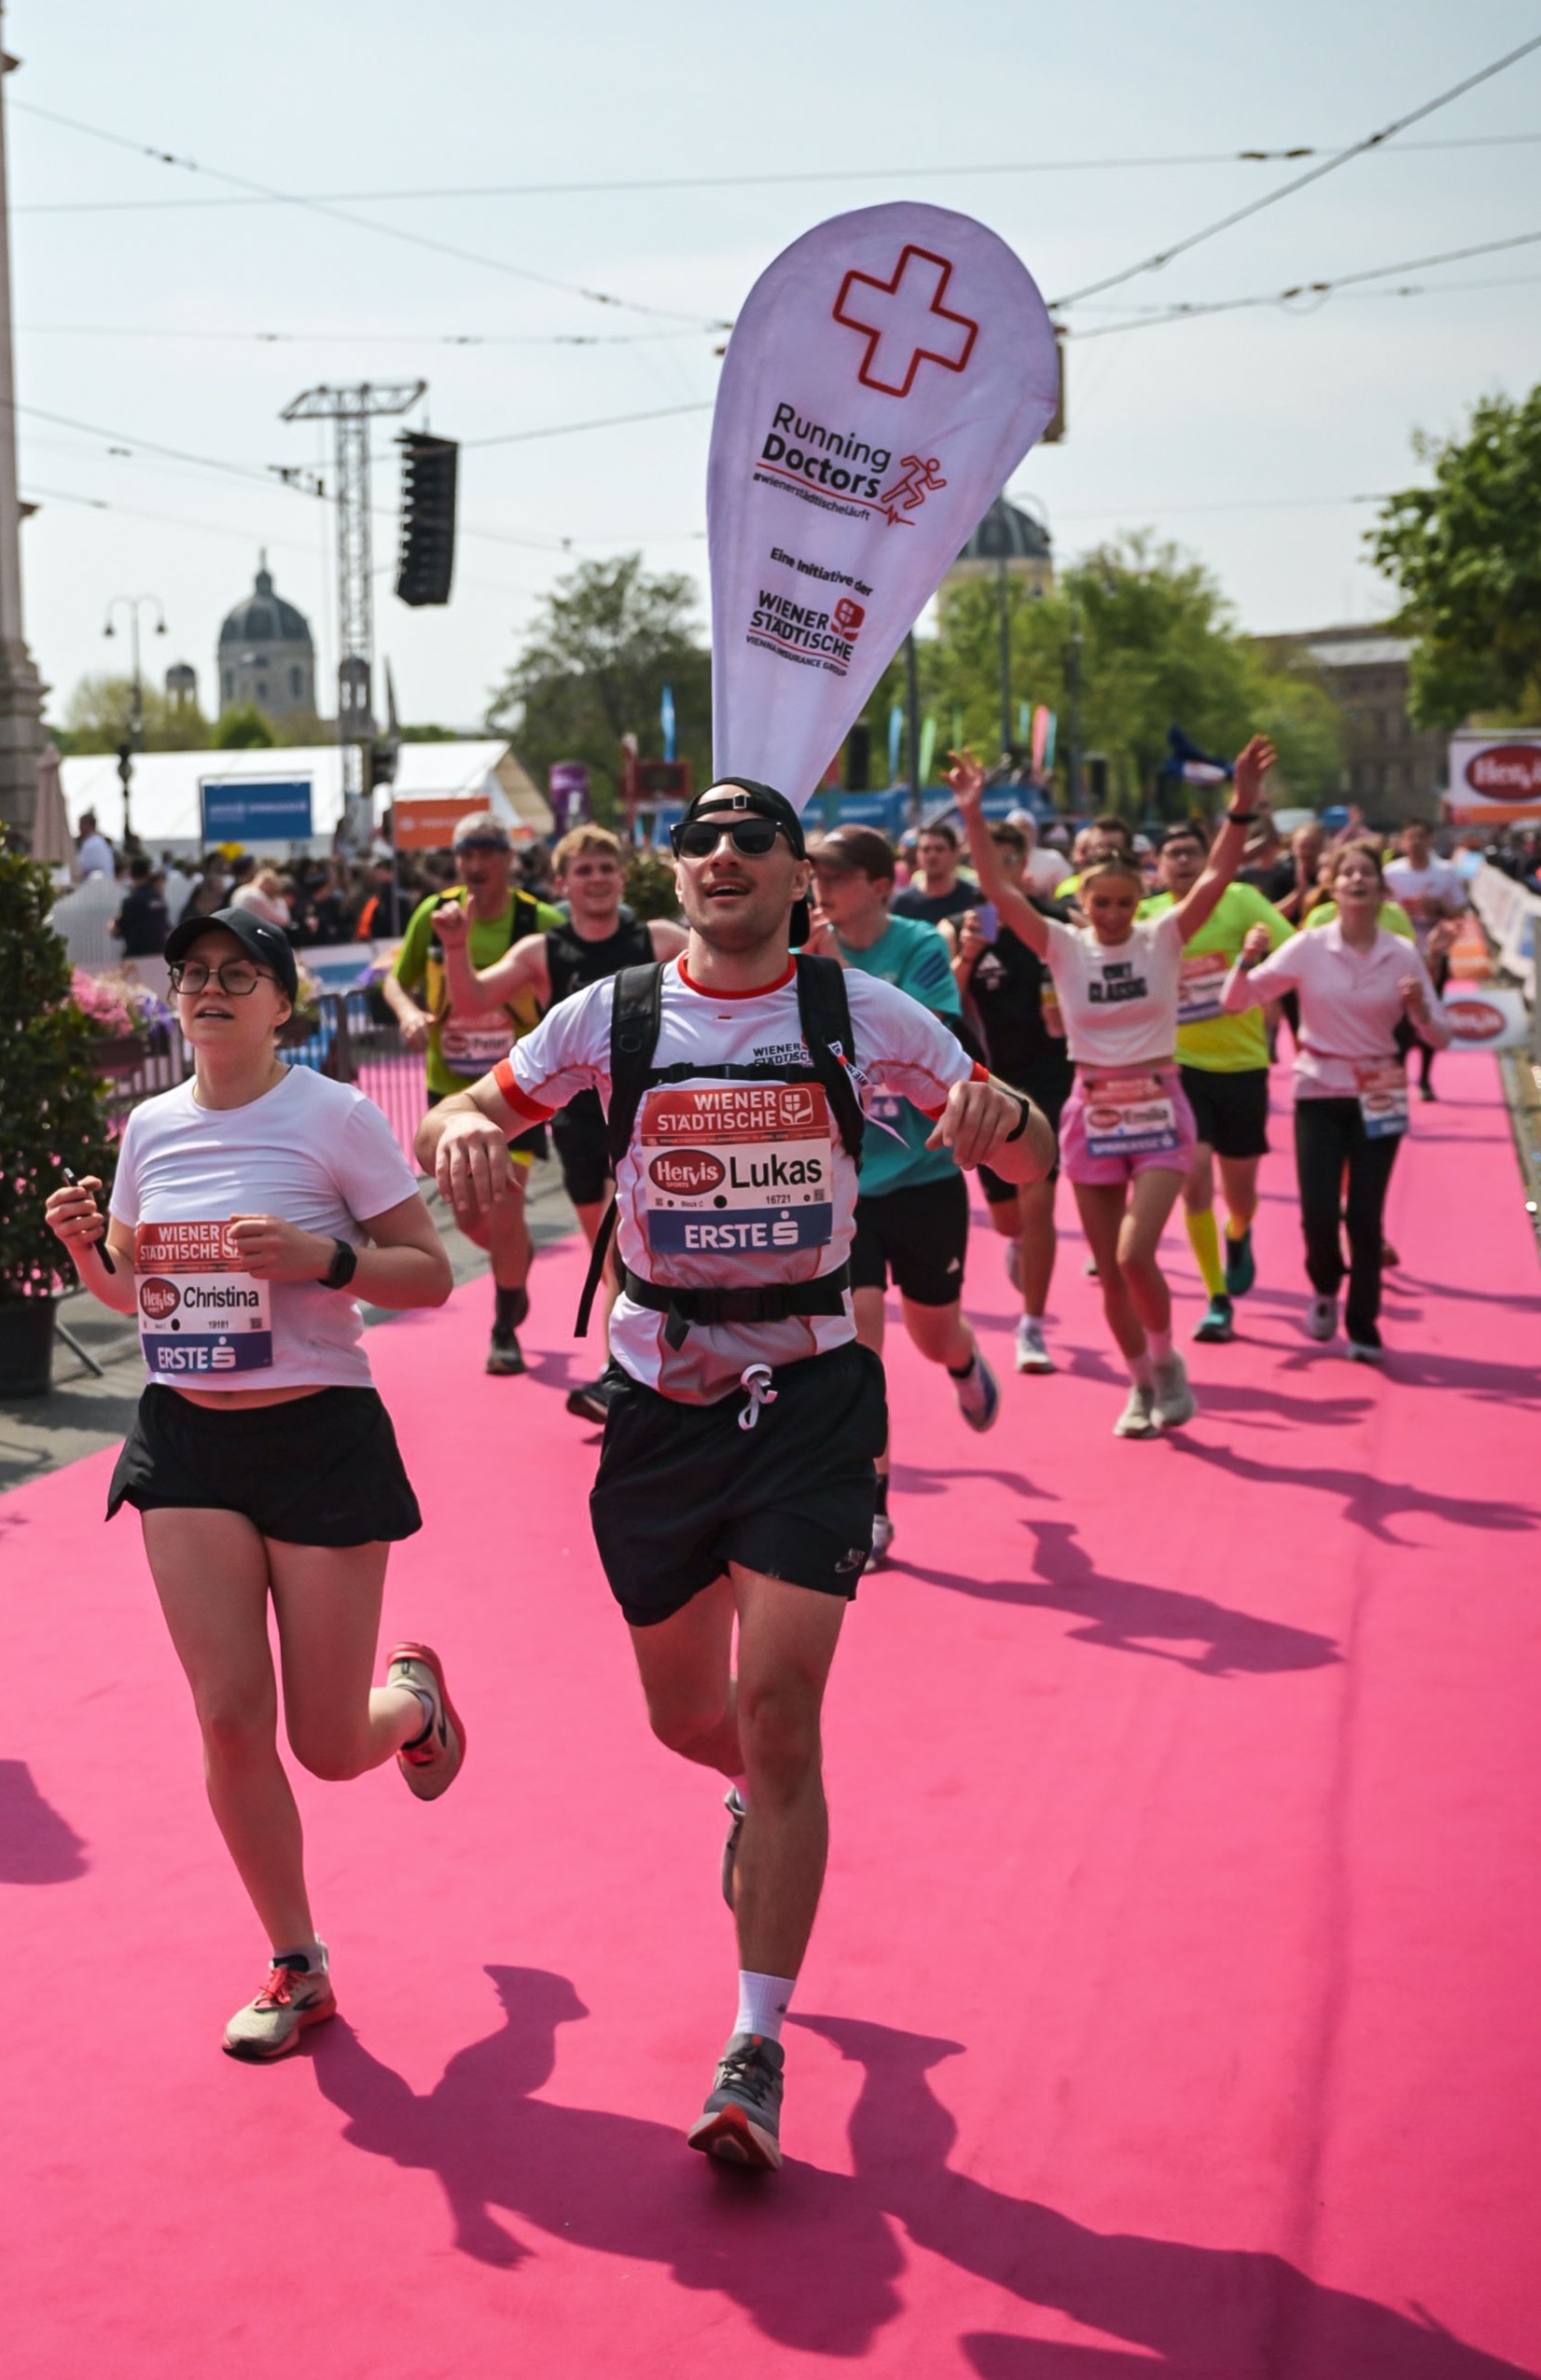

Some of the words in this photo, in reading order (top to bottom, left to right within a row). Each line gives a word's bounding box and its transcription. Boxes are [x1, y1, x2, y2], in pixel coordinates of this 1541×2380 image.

[772, 402, 892, 474] Running
[761, 433, 881, 498] Doctors
[770, 547, 795, 567] Eine
[797, 560, 854, 587] Initiative
[854, 580, 874, 597] der
[759, 589, 829, 630] WIENER
[750, 610, 854, 662] STÄDTISCHE
[753, 1043, 800, 1057] WIENER
[693, 1090, 777, 1111] WIENER
[658, 1110, 777, 1130] STÄDTISCHE
[657, 1161, 719, 1185] Hervis
[729, 1154, 823, 1188] Lukas
[766, 1195, 791, 1204] 16721
[159, 1225, 220, 1242] WIENER
[685, 1223, 768, 1248] ERSTE
[140, 1243, 219, 1261] STÄDTISCHE
[143, 1287, 175, 1310] Hervis
[184, 1286, 259, 1308] Christina
[157, 1347, 208, 1370] ERSTE
